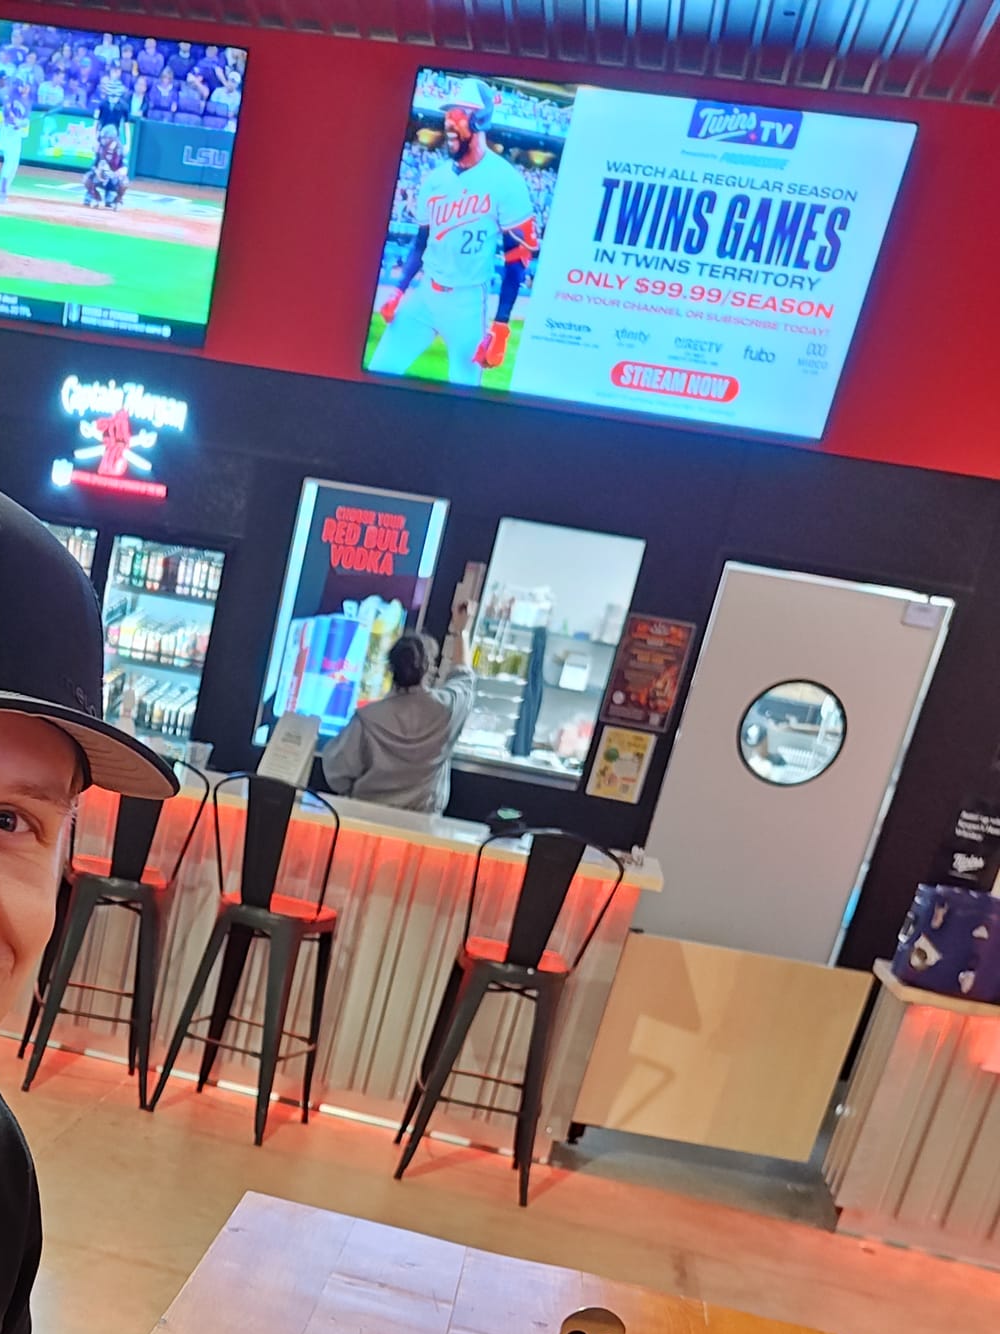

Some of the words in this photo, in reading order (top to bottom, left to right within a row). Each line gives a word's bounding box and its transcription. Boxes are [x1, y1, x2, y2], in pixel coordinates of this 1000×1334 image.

[698, 106, 757, 142] Twins
[760, 120, 793, 146] TV
[182, 145, 228, 169] LSU
[606, 160, 665, 178] WATCH
[669, 168, 698, 183] ALL
[703, 173, 784, 193] REGULAR
[786, 183, 858, 203] SEASON
[426, 187, 492, 226] Twins
[592, 177, 718, 256] TWINS
[715, 193, 852, 272] GAMES
[460, 229, 488, 256] 25
[593, 248, 616, 264] IN
[620, 252, 690, 274] TWINS
[696, 261, 822, 292] TERRITORY
[567, 268, 630, 291] ONLY
[633, 276, 835, 320] $99.99/SEASON
[585, 294, 621, 309] YOUR
[621, 300, 682, 319] CHANNEL
[685, 310, 704, 320] OR
[705, 312, 779, 332] SUBSCRIBE
[744, 345, 776, 365] fubo
[619, 362, 686, 392] STREAM
[688, 376, 732, 398] NOW
[321, 517, 361, 547] RED
[363, 524, 411, 555] BULL
[329, 541, 394, 577] VODKA
